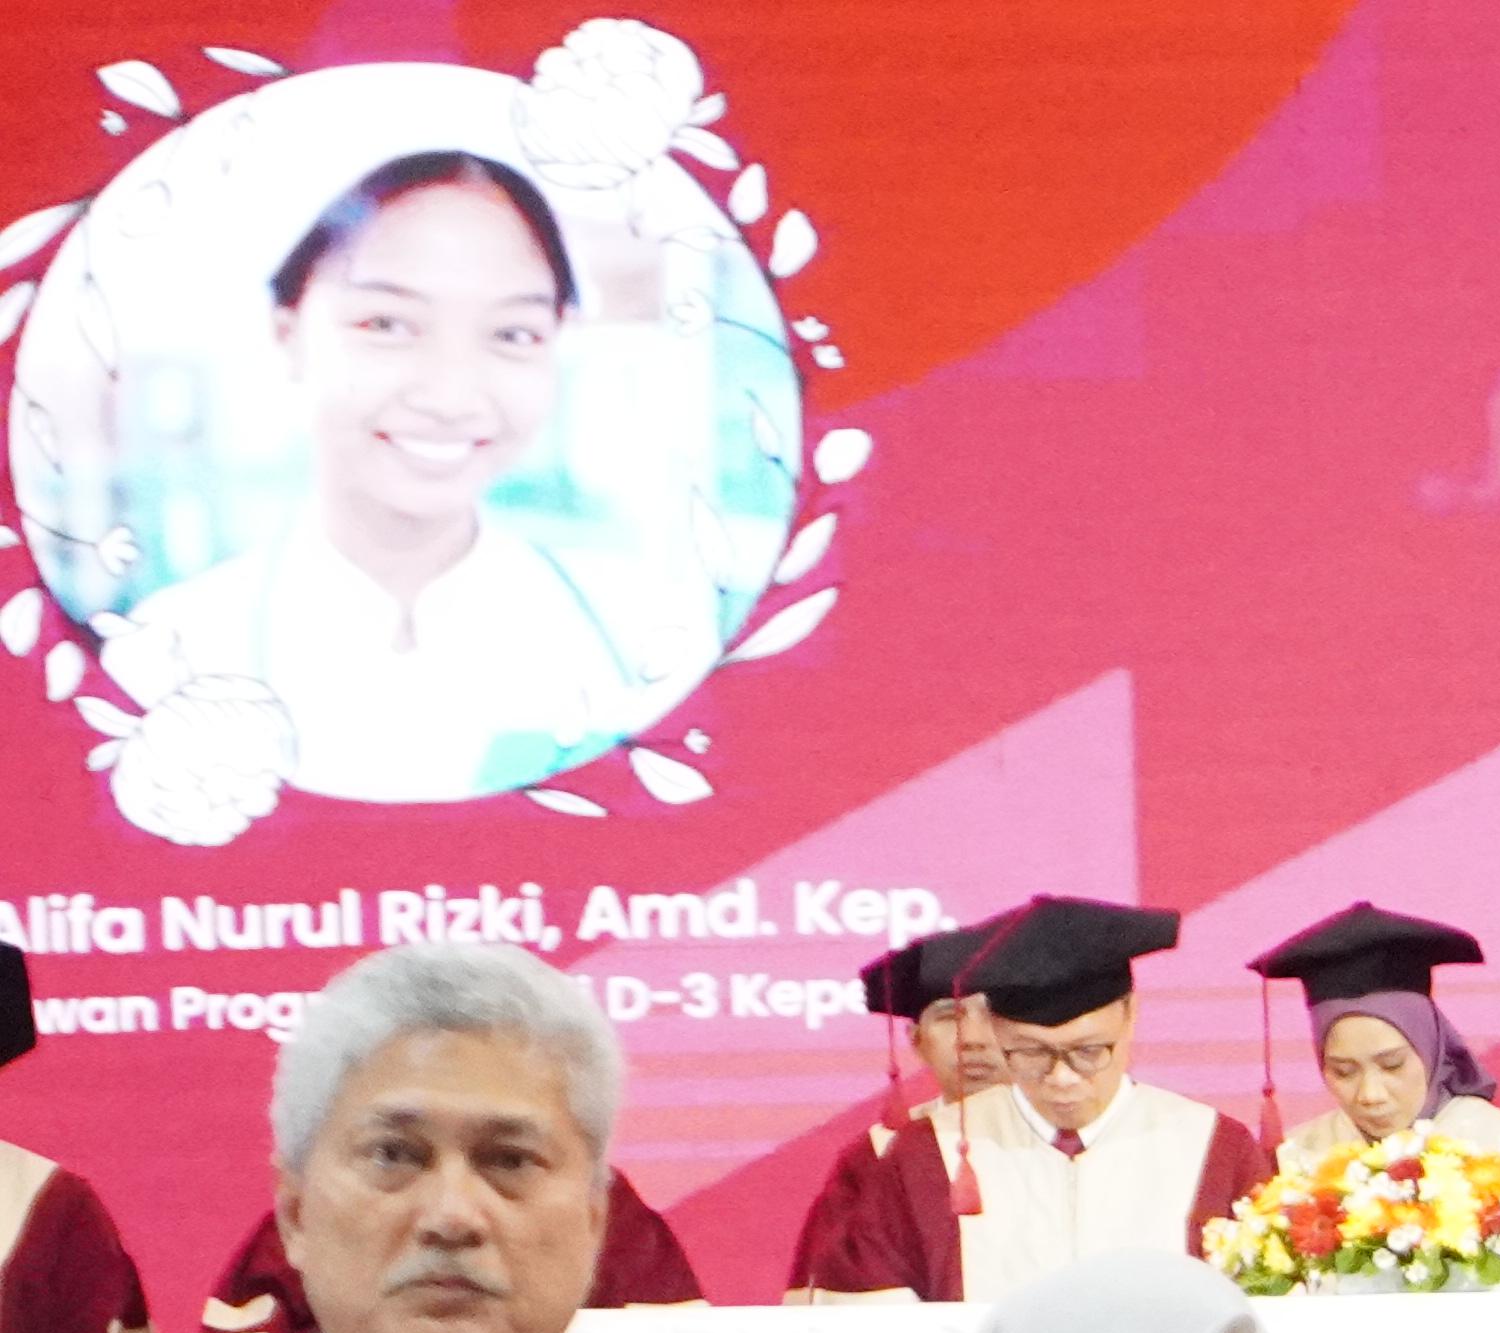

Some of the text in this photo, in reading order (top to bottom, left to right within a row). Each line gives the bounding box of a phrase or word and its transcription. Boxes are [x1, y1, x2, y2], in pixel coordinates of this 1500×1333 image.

[161, 887, 361, 951] Nurul
[378, 882, 562, 951] Rizki,
[577, 878, 778, 941] Amd.
[793, 879, 960, 950] Kep.
[606, 972, 718, 1023] D-3
